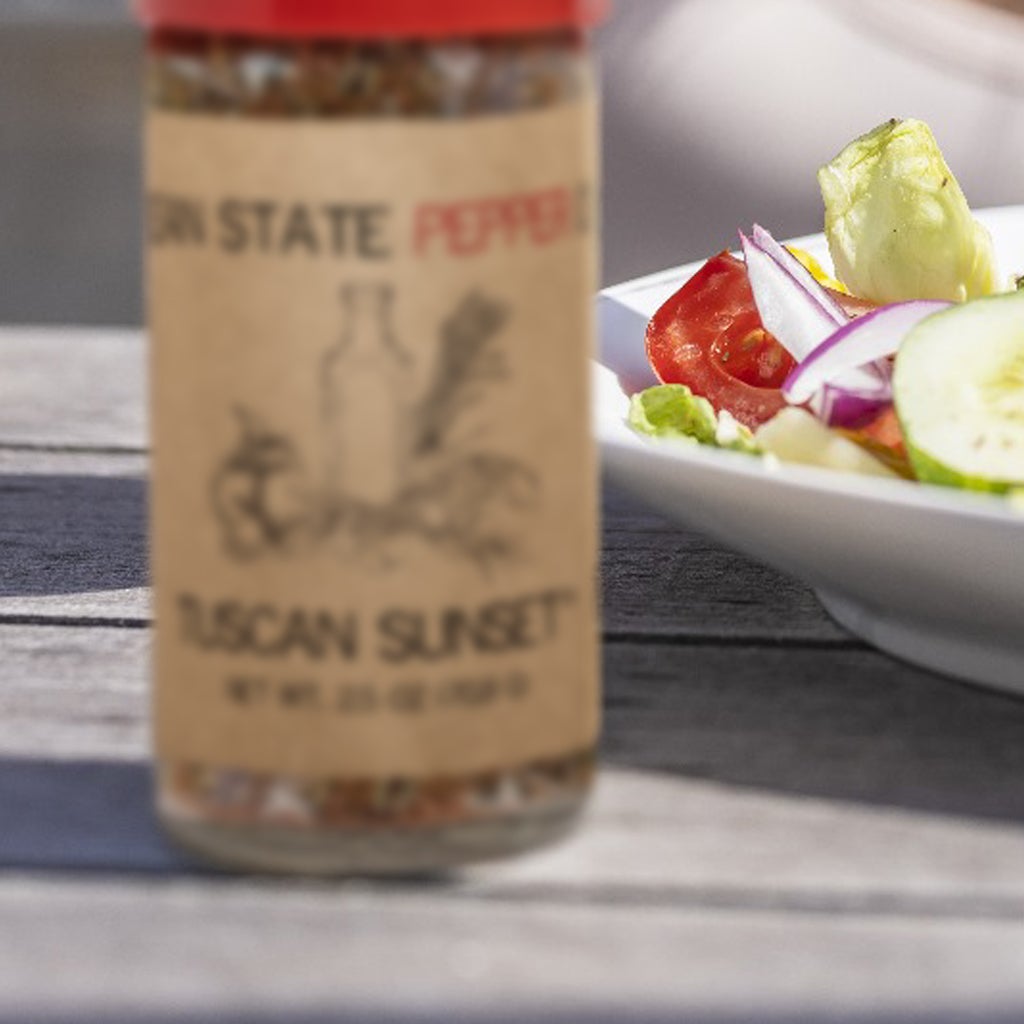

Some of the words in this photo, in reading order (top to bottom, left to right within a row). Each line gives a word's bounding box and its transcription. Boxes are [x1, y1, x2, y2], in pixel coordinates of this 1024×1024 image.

[216, 195, 392, 261] STATE
[175, 591, 358, 662] TUSCAN
[376, 588, 568, 663] SUNSET
